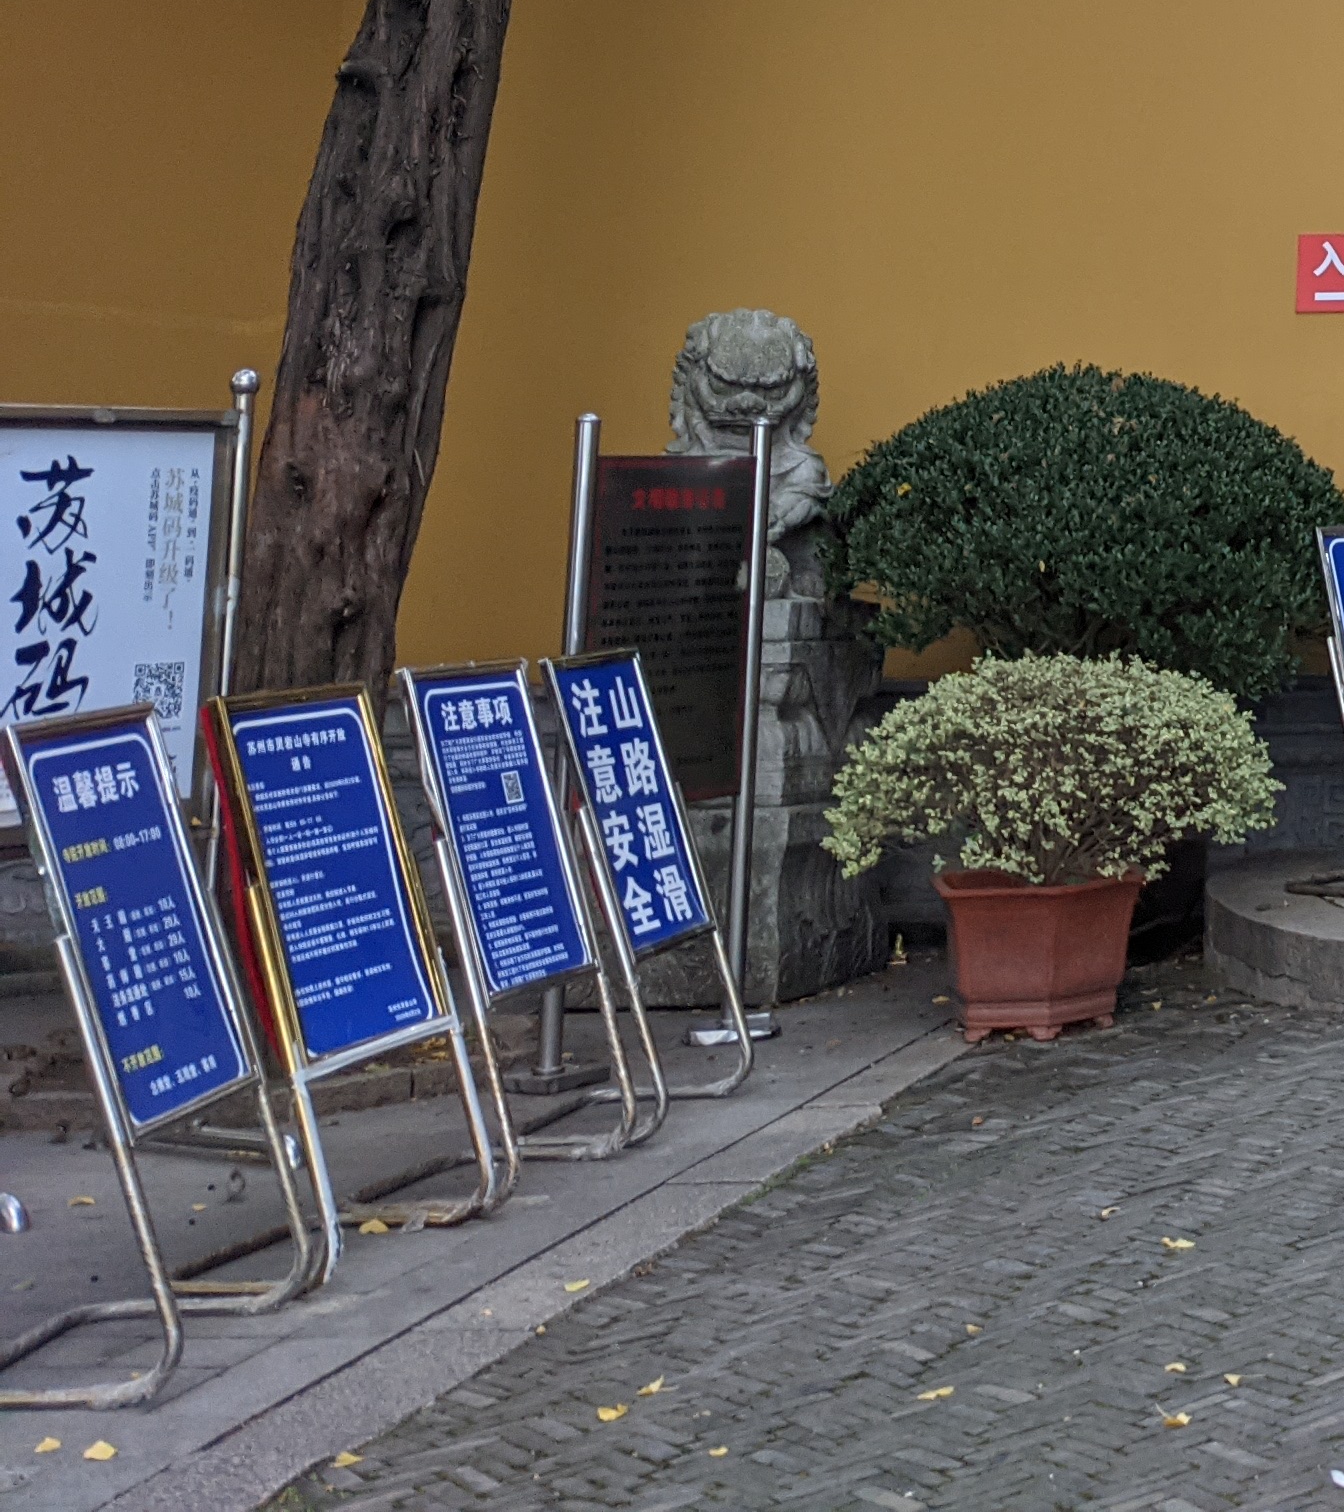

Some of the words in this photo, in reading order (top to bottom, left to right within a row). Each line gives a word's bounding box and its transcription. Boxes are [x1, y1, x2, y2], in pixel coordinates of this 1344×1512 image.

[0, 454, 98, 720] 苏城码
[52, 761, 139, 813] 温馨提示
[440, 695, 513, 732] 注意事项
[571, 678, 661, 936] 注意安全
[608, 675, 694, 922] 山路湿滑
